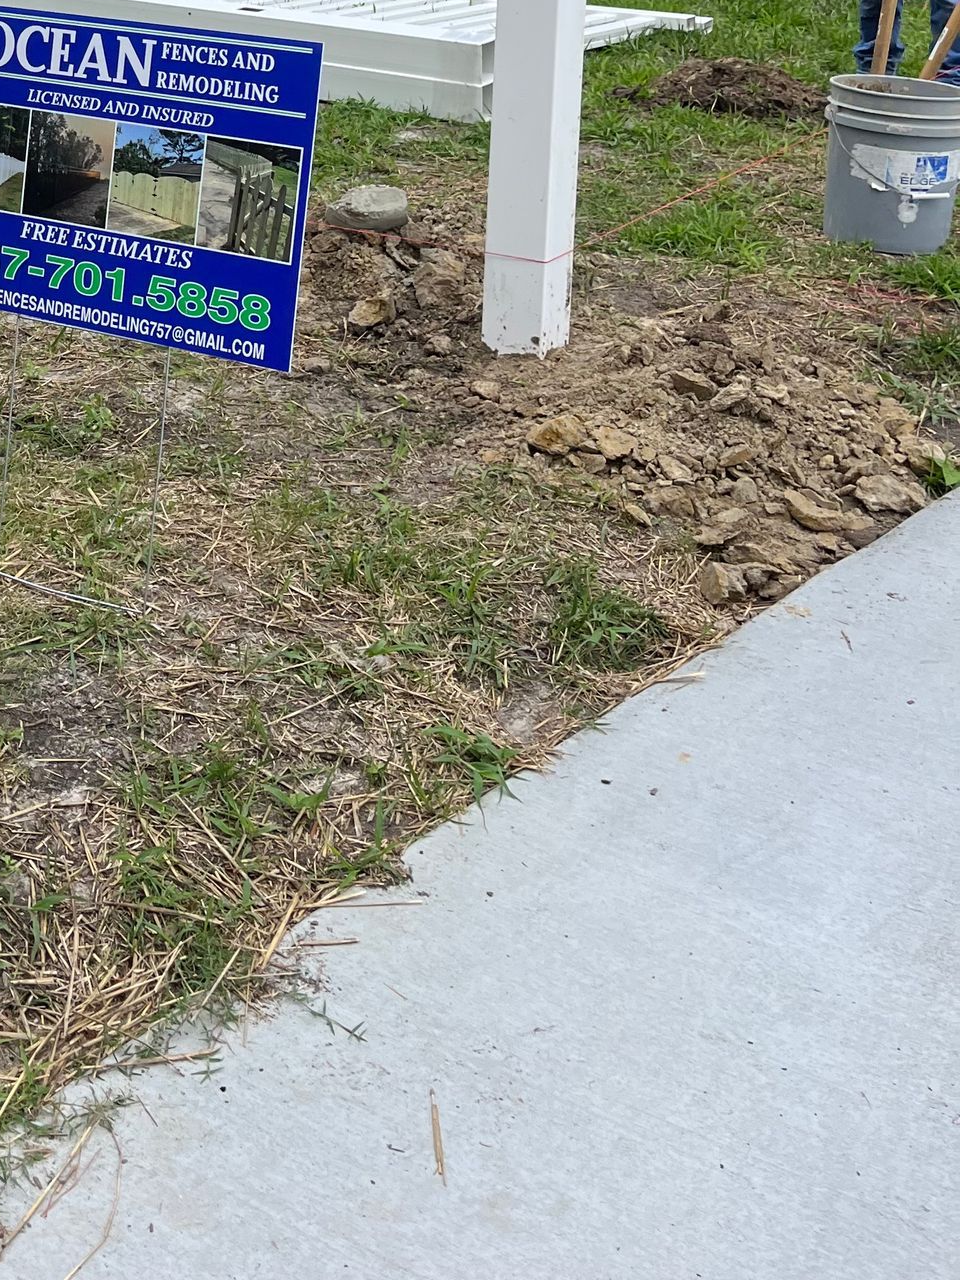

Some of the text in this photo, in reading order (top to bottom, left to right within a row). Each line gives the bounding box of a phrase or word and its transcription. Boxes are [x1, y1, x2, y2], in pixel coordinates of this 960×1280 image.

[161, 41, 228, 67] FENCES
[232, 50, 275, 72] AND
[155, 70, 279, 104] REMODELING
[26, 88, 215, 128] LICENSED AND INSURED
[19, 220, 193, 270] FREE ESTIMATES
